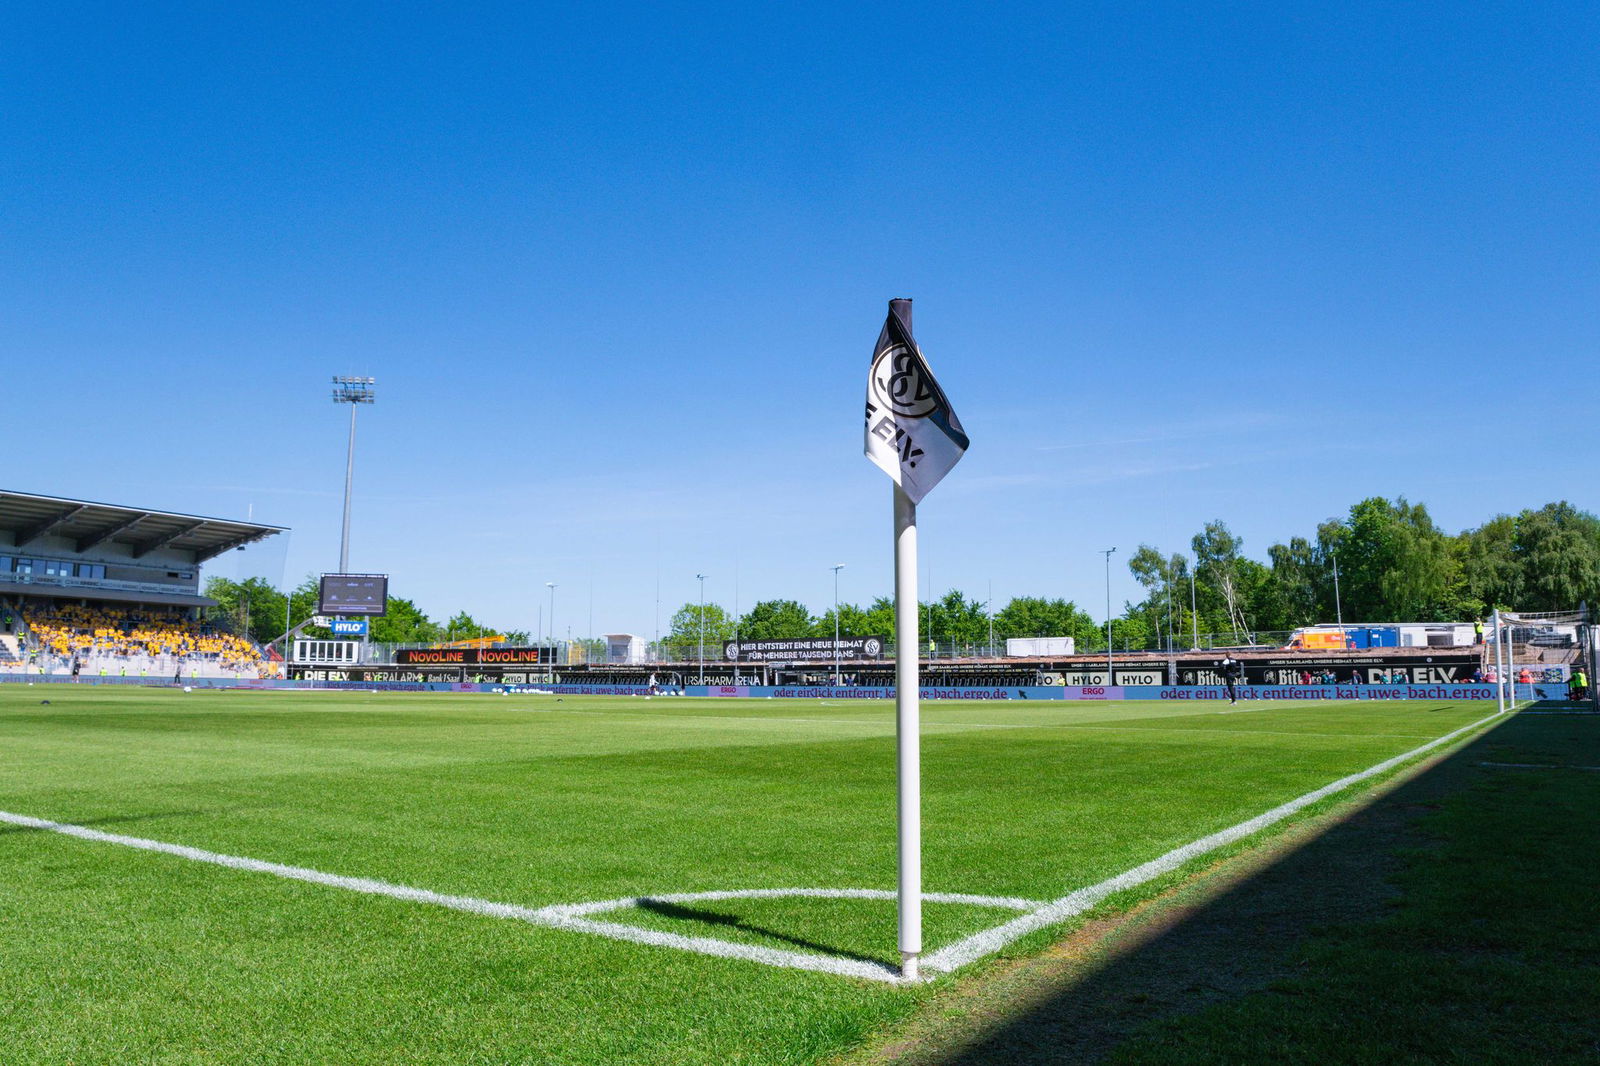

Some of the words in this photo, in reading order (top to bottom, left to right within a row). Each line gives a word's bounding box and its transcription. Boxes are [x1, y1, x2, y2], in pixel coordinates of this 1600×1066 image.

[871, 415, 924, 469] ELV.
[740, 643, 757, 651] HIER
[758, 642, 793, 650] ENTSTEHT
[794, 641, 811, 649] EINE
[812, 641, 832, 649] NEUE
[748, 650, 763, 660] FÜR
[764, 651, 798, 659] MEHRERE
[799, 651, 832, 659] TAUSEND
[833, 650, 854, 658] FANS
[304, 670, 326, 681] DIE
[1072, 676, 1102, 685] HYLO
[1122, 675, 1153, 685] HYLO
[1413, 667, 1459, 684] ELV.
[774, 688, 796, 698] oder
[1160, 687, 1192, 700] oder
[1195, 687, 1218, 700] ein
[1262, 687, 1332, 700] entfernt:
